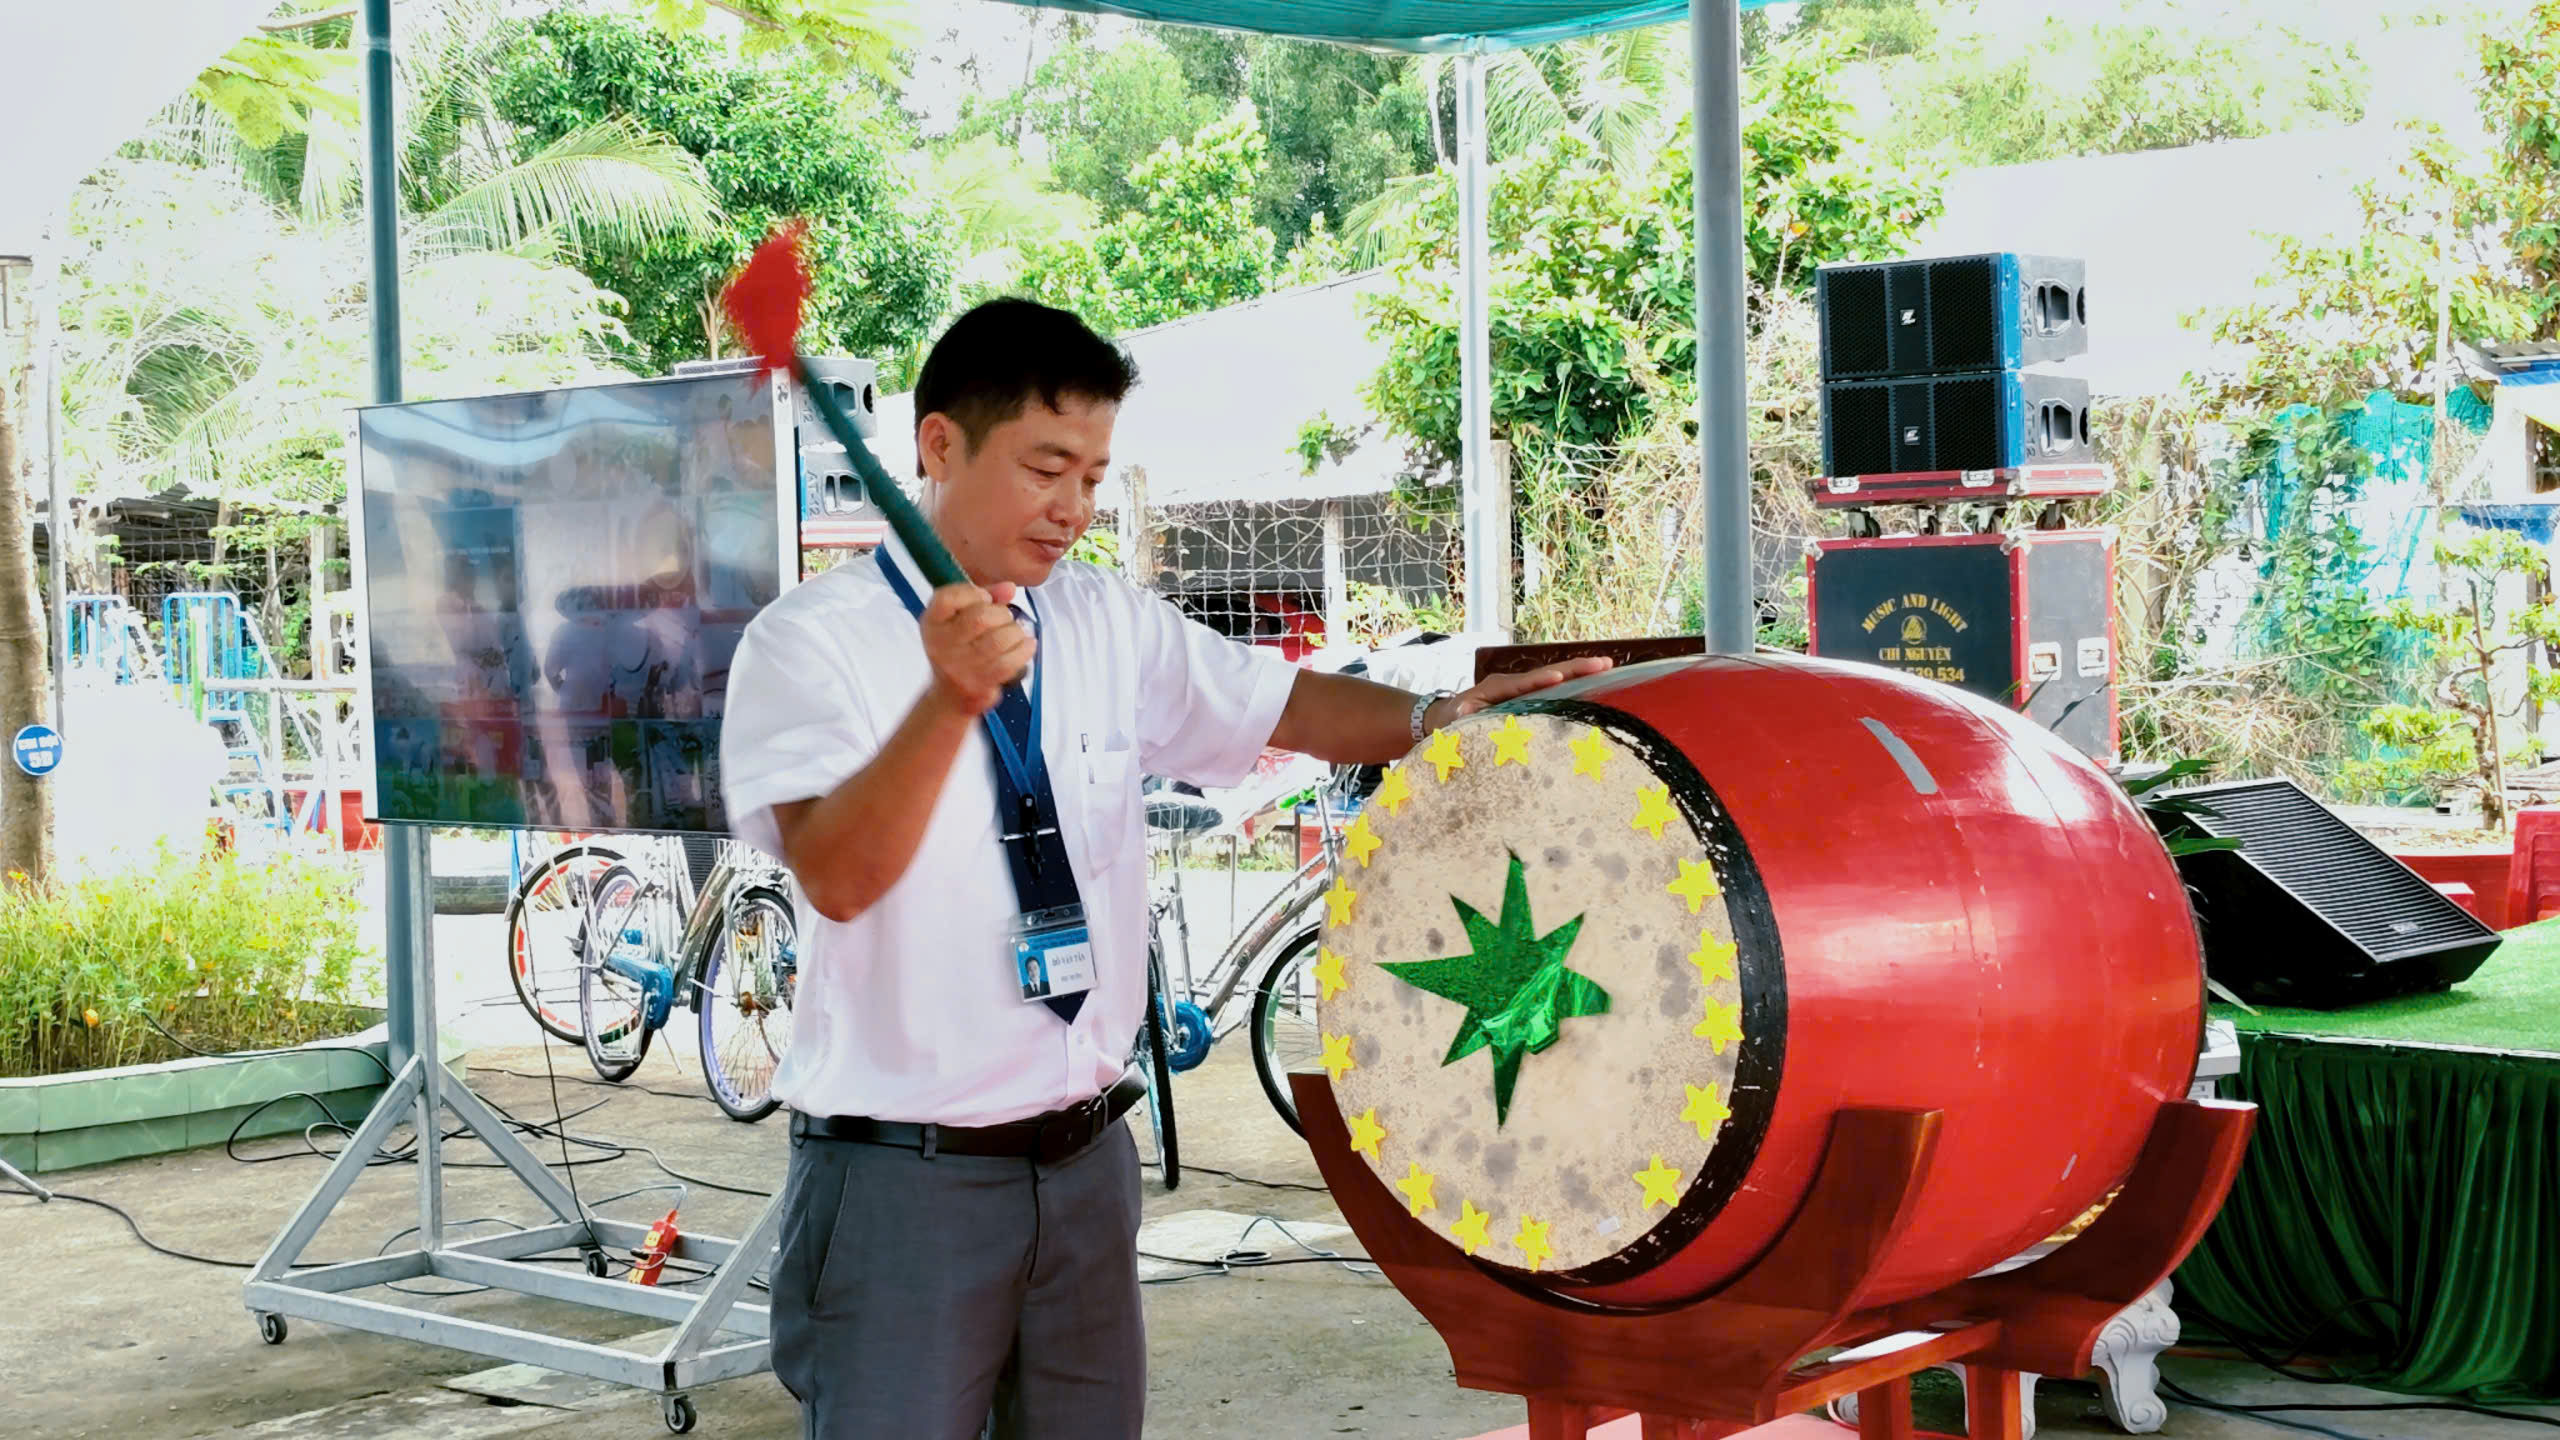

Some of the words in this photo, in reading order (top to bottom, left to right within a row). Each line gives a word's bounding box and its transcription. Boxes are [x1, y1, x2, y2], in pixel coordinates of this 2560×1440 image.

[1861, 598, 1897, 634] MUSIC
[1901, 593, 1927, 608] AND
[1930, 597, 1968, 633] LIGHT
